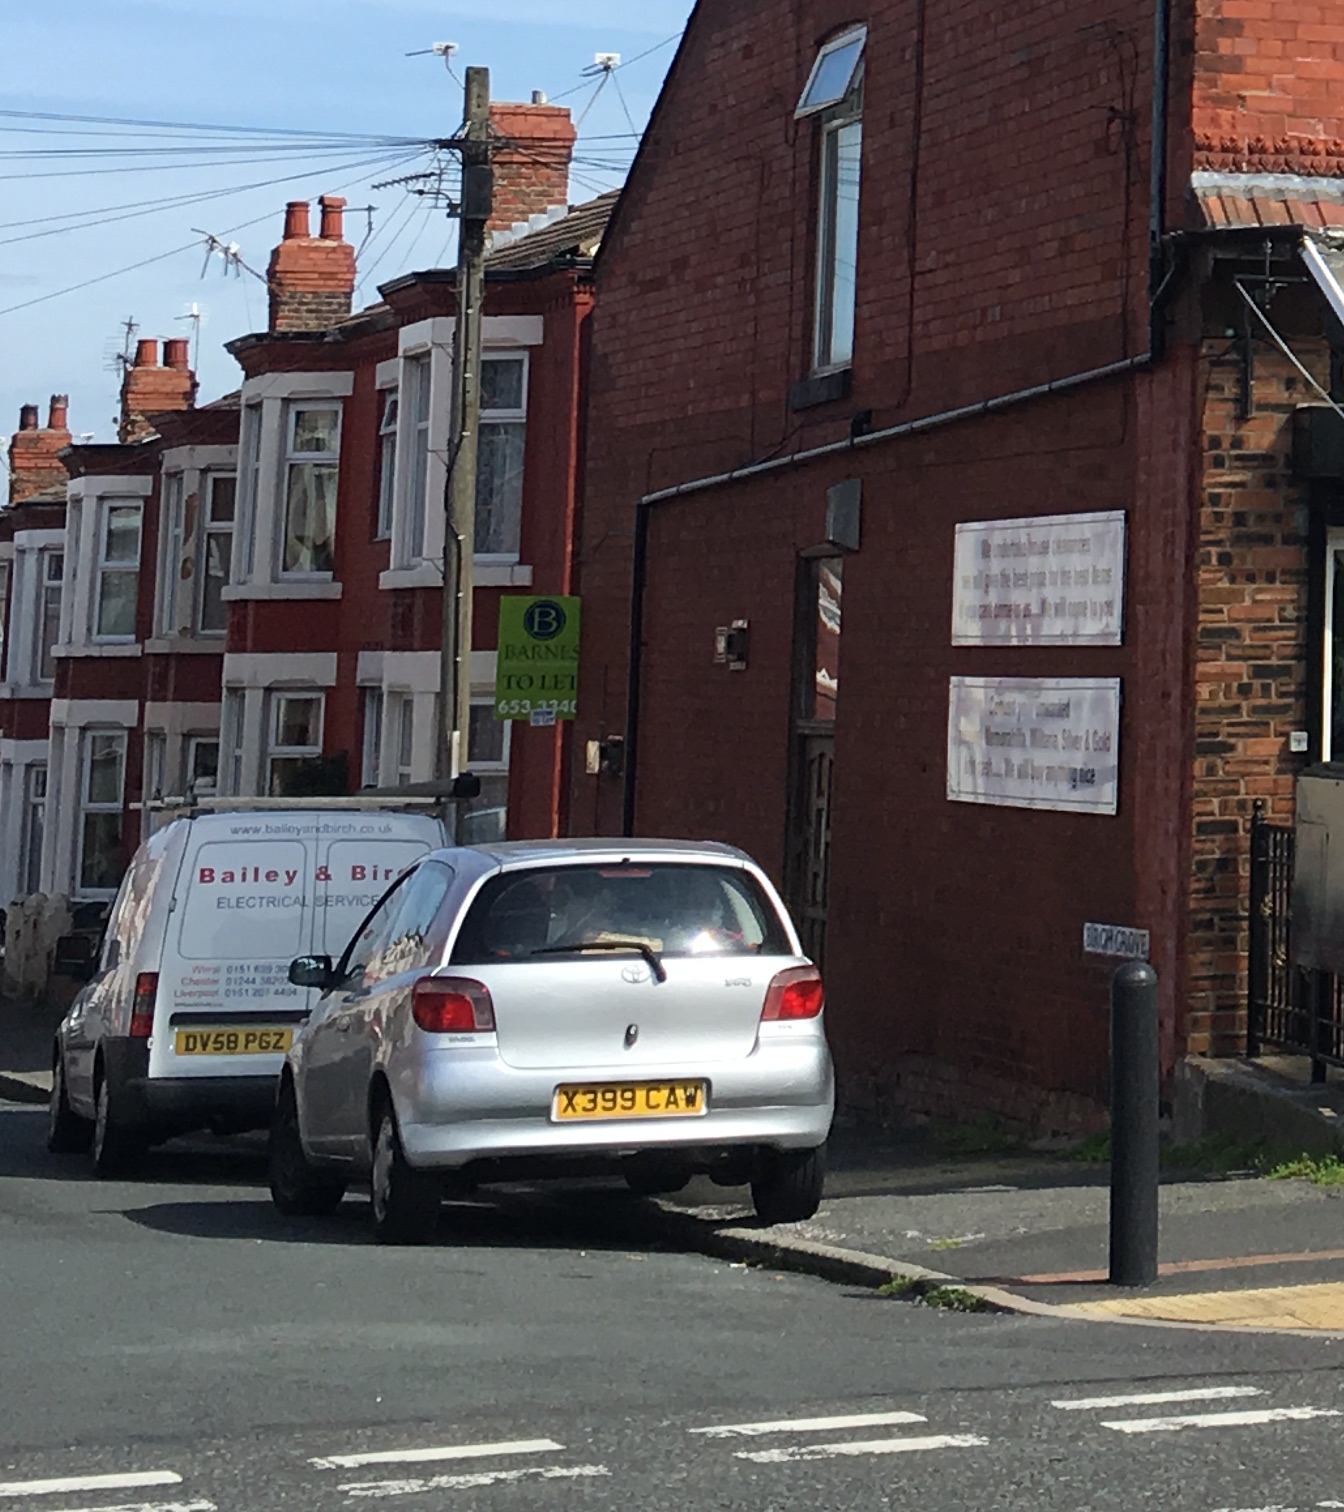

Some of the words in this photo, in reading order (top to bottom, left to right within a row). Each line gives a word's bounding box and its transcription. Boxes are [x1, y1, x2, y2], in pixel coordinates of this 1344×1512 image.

[504, 644, 580, 661] BARNES
[502, 674, 534, 690] TO
[540, 674, 576, 691] LET
[498, 699, 531, 715] 653
[199, 866, 298, 886] Bailey
[315, 866, 332, 881] &
[216, 895, 309, 910] ELECTRICAL
[314, 894, 381, 908] SERVICE
[226, 965, 250, 974] 0151
[184, 1032, 239, 1052] DV58
[243, 1032, 285, 1050] PGZ
[562, 1088, 637, 1114] X399
[645, 1085, 699, 1109] CAW
